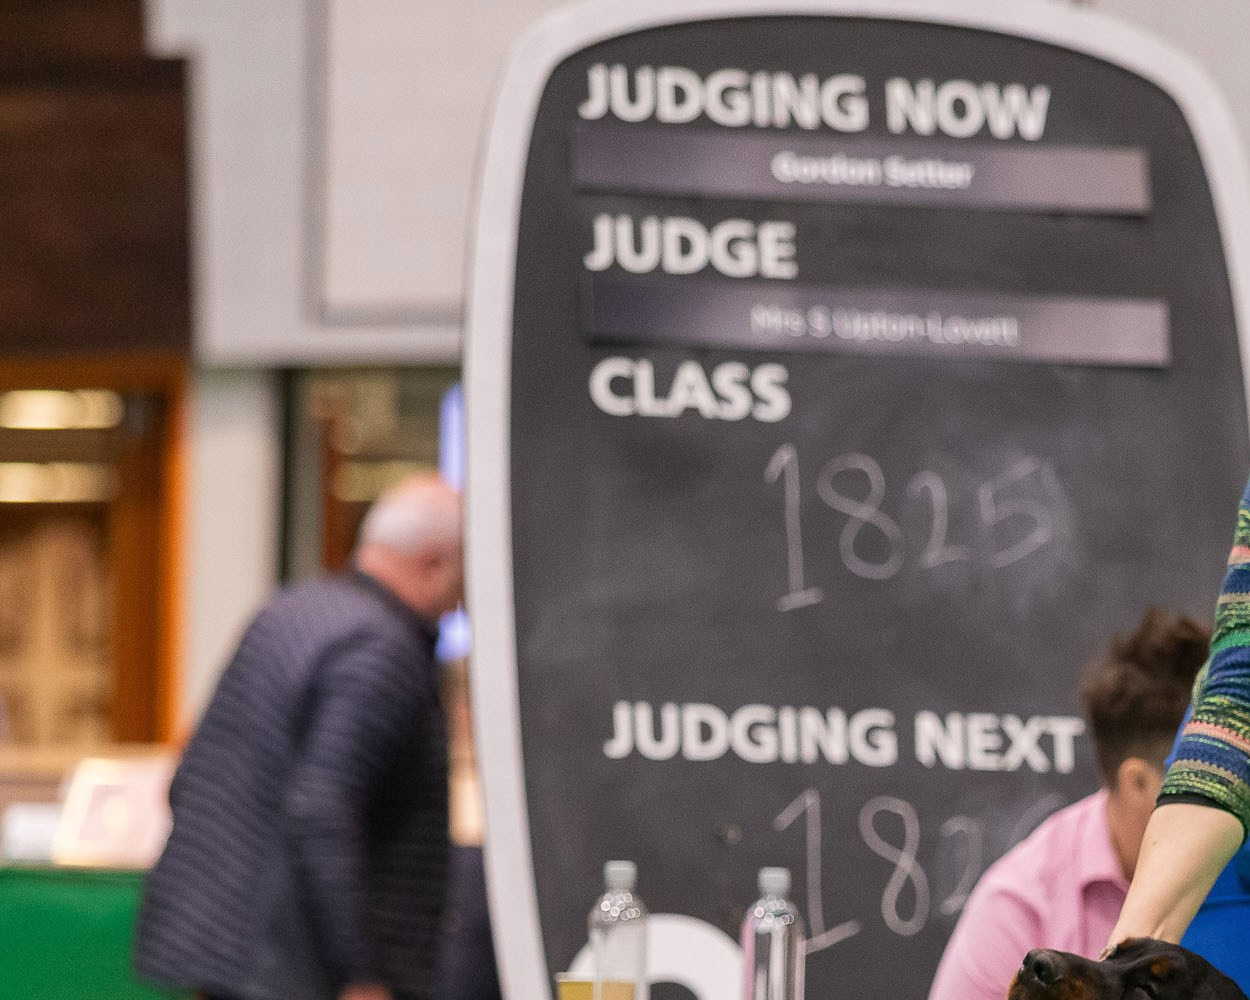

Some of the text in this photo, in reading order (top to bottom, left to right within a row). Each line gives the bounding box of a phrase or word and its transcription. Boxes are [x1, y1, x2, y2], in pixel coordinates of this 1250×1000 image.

[578, 62, 1051, 142] JUDGING NOW
[770, 150, 975, 190] Gordon Setter
[583, 213, 799, 280] JUDGE
[588, 356, 793, 423] CLASS
[763, 442, 1054, 612] 1825
[602, 699, 1087, 775] JUDGING NEXT
